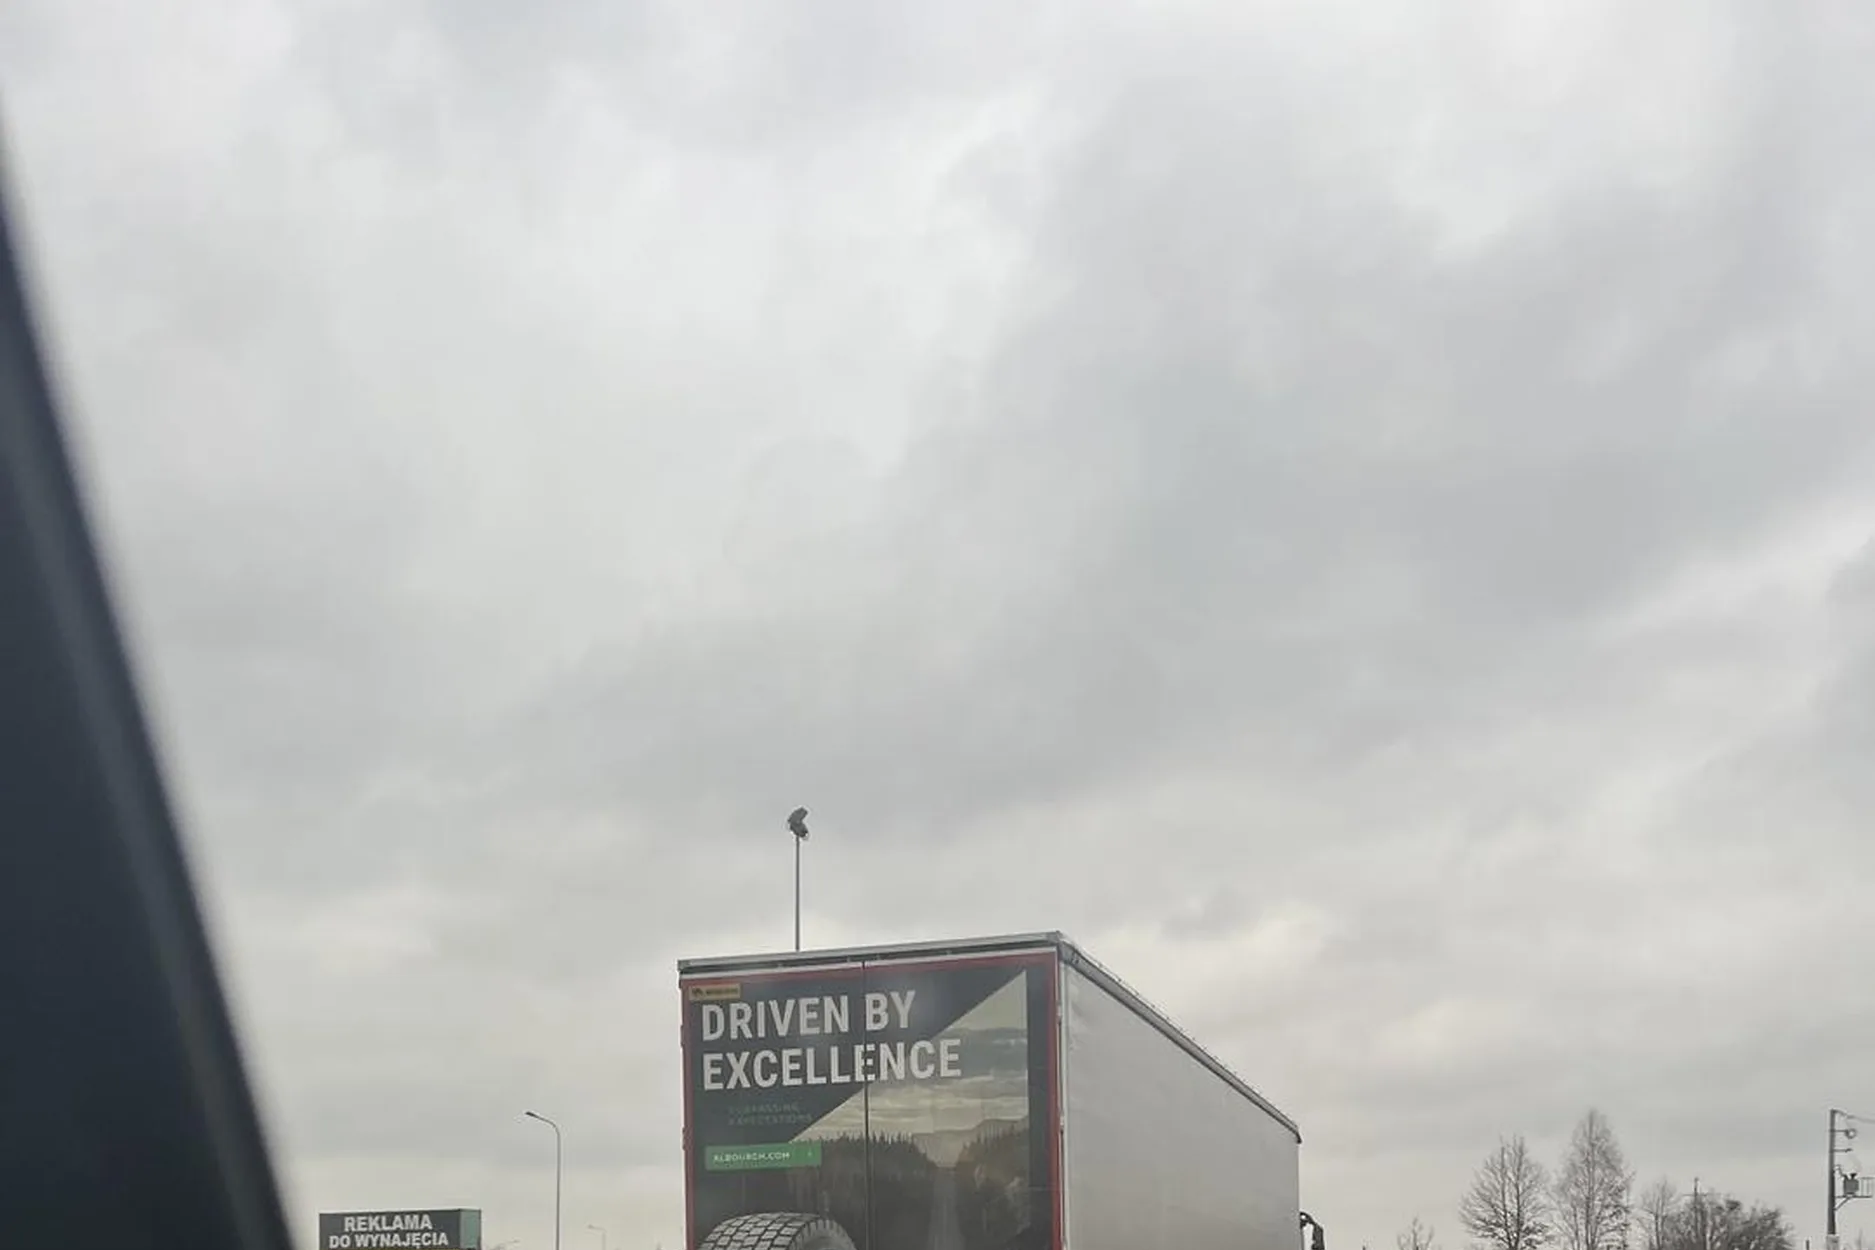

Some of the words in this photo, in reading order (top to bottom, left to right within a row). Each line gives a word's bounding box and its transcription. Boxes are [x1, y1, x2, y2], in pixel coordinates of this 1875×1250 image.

[701, 995, 850, 1041] DRIVEN
[865, 990, 916, 1031] BY
[702, 1038, 962, 1090] EXCELLENCE
[343, 1214, 433, 1232] REKLAMA
[329, 1235, 351, 1249] DO
[355, 1232, 449, 1249] WYNAJĘCIA
